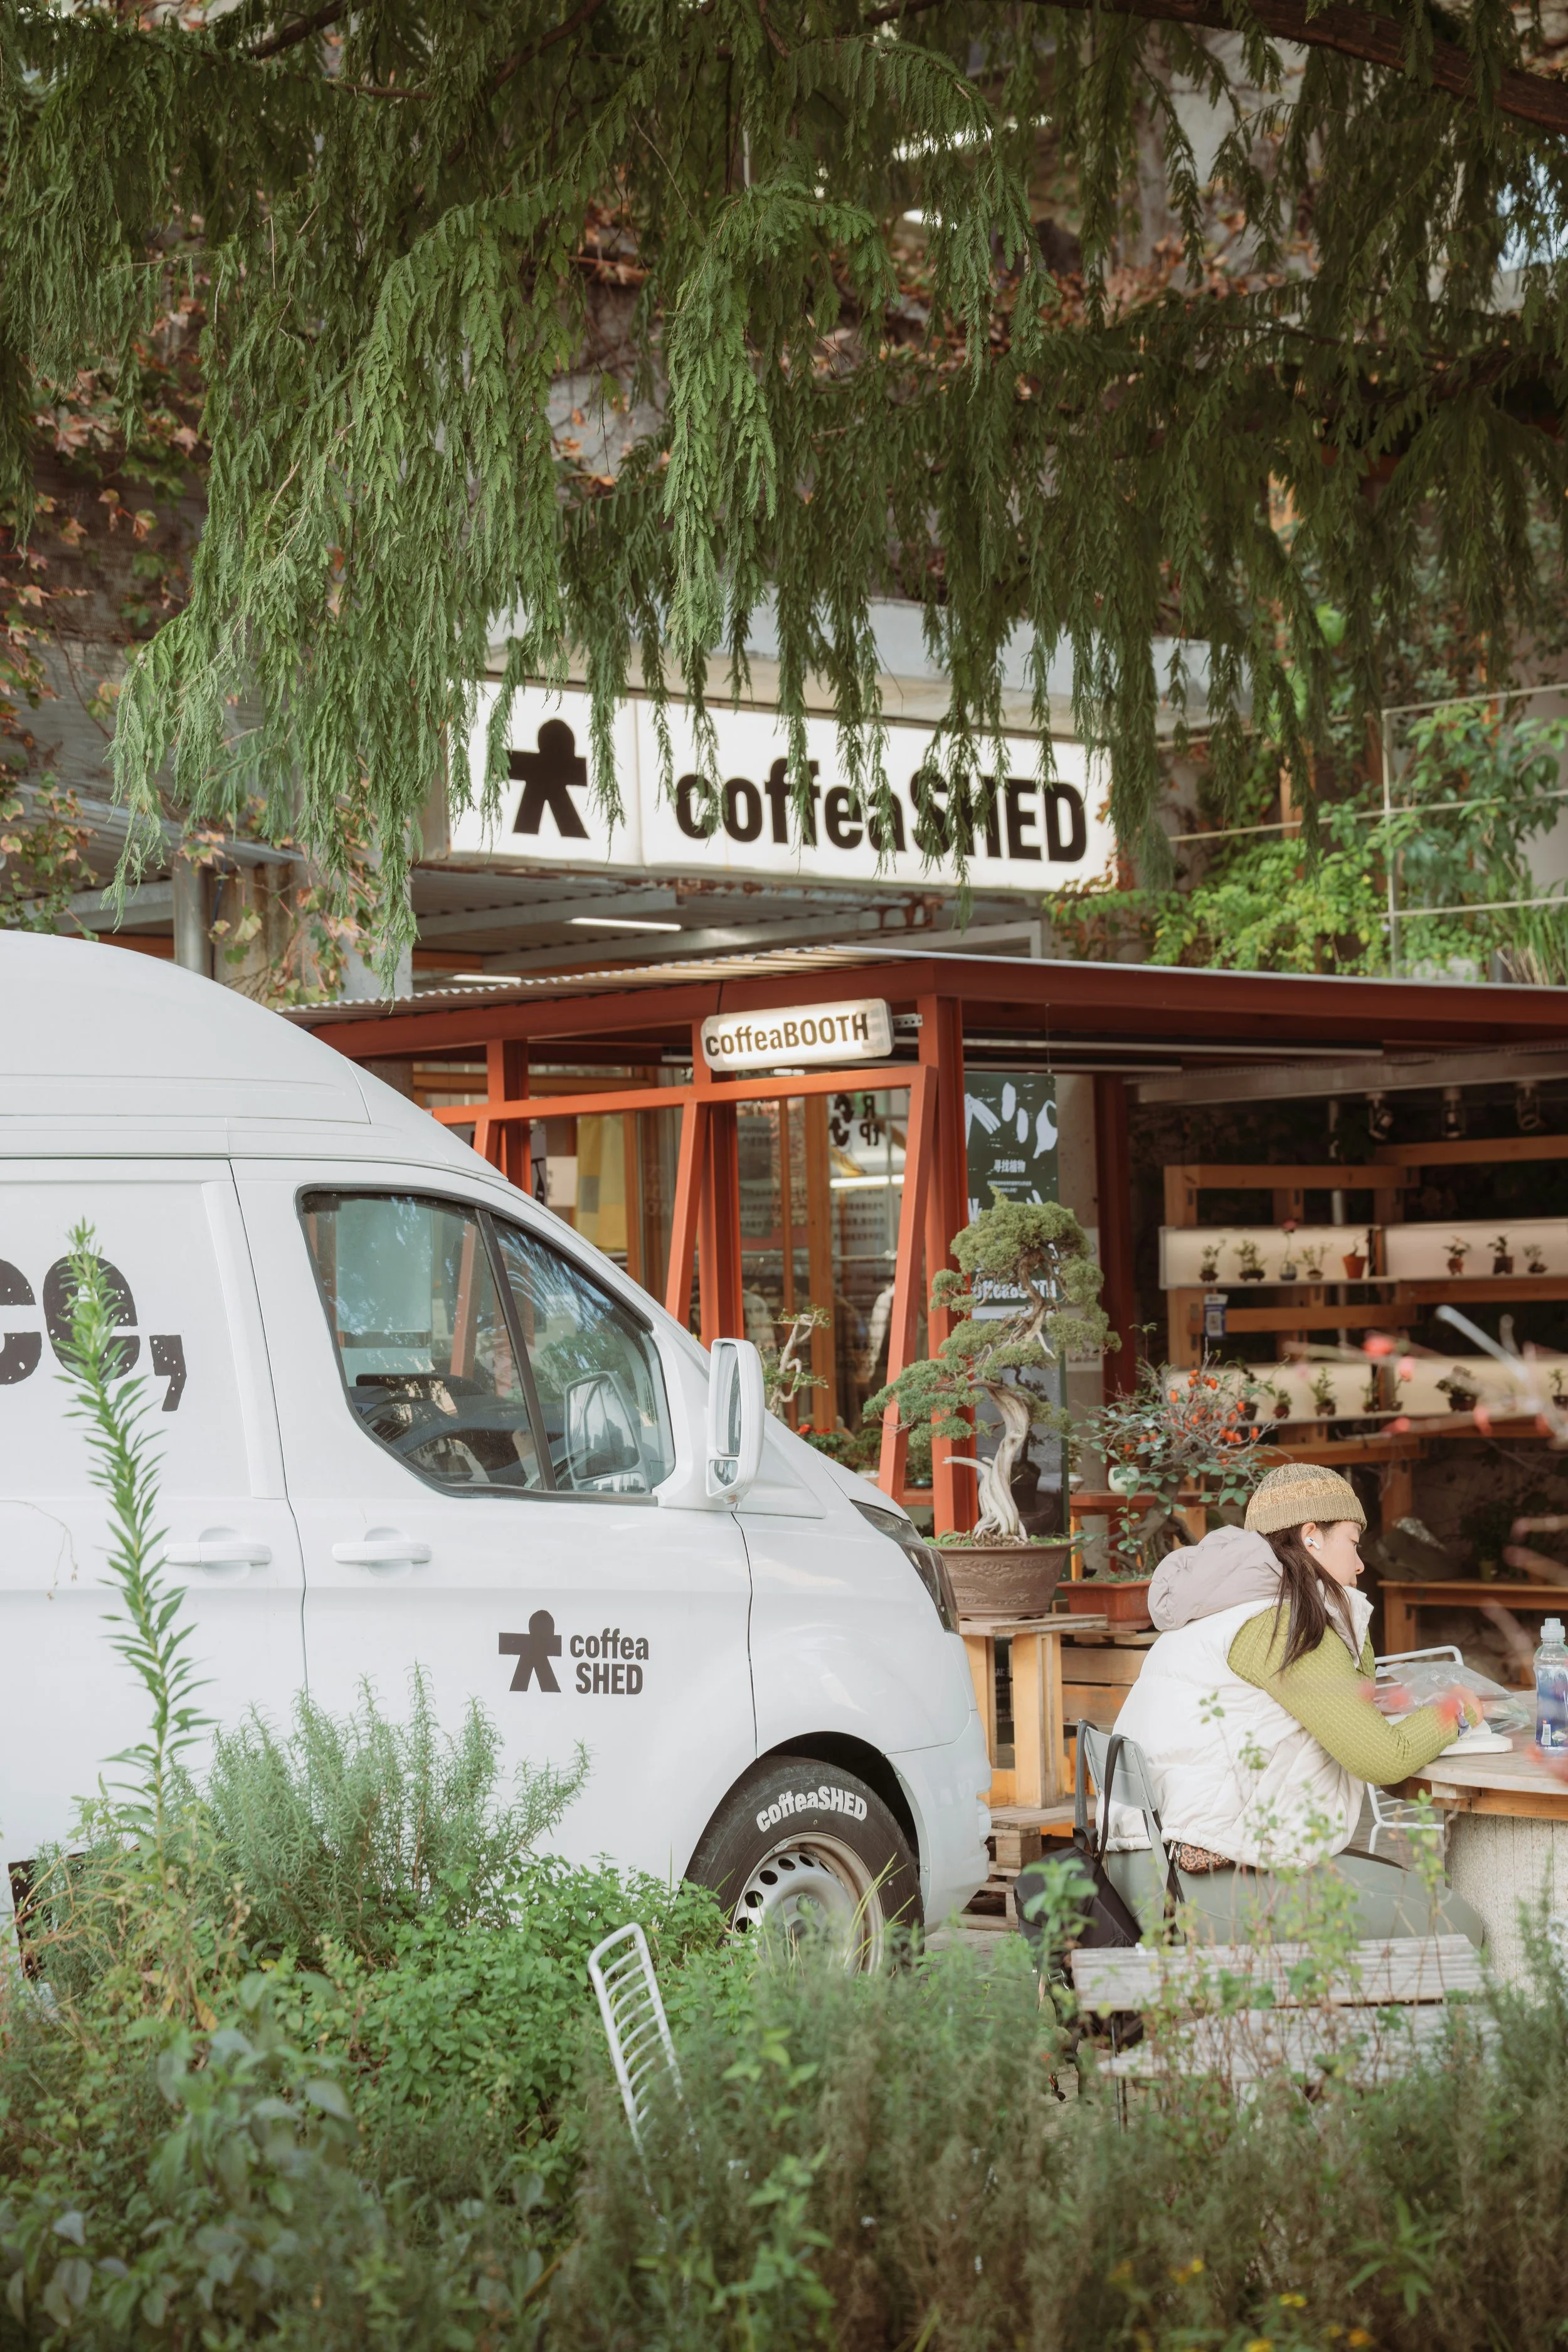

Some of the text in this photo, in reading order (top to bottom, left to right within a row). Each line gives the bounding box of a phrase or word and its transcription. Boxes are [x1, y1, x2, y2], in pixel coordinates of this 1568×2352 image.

[705, 1013, 869, 1056] coffeaBOOTH
[569, 1628, 649, 1660] coffea
[575, 1662, 643, 1695] SHED
[756, 1786, 867, 1832] coffeaSHED
